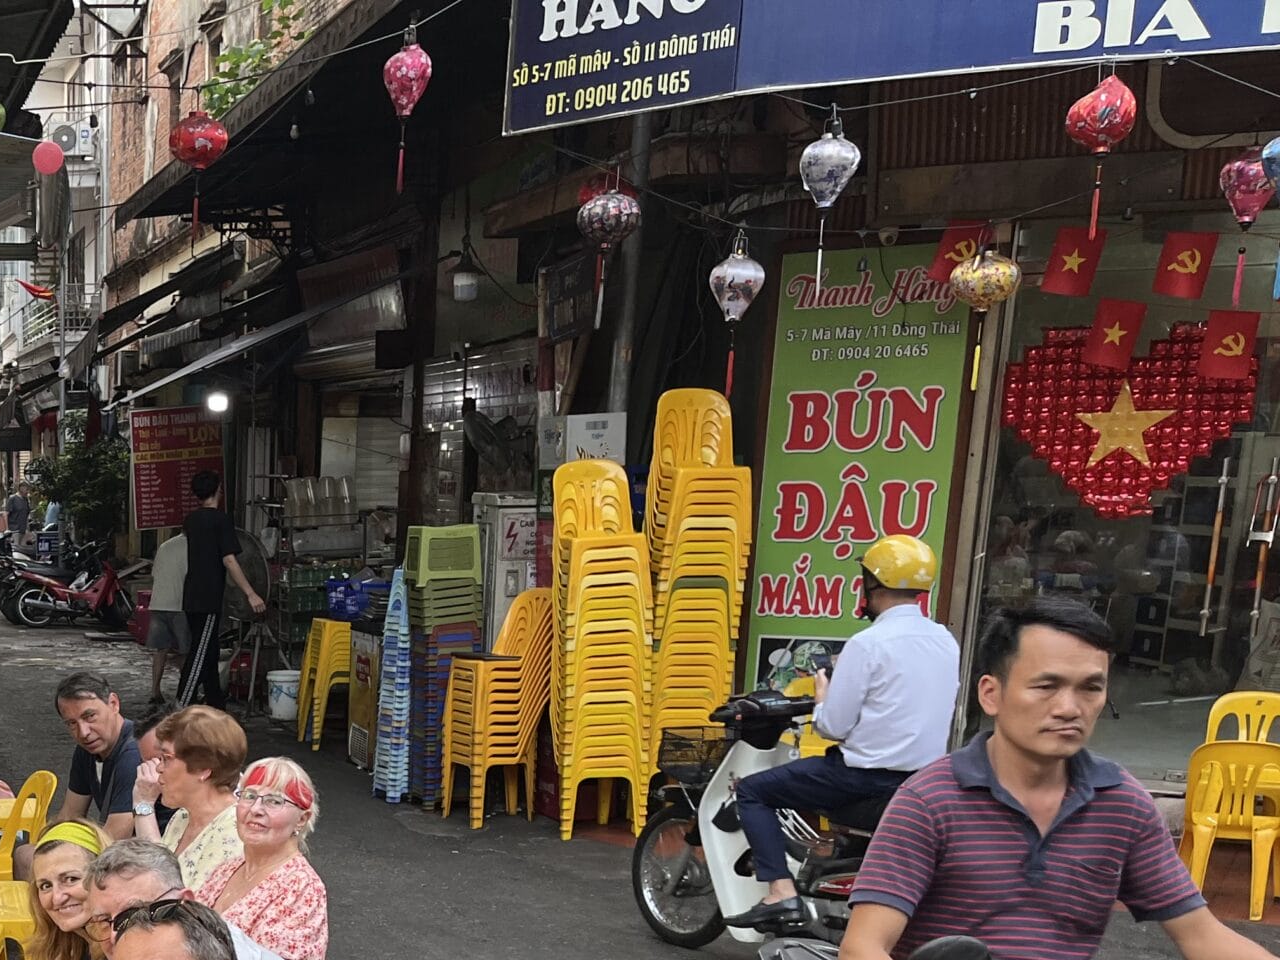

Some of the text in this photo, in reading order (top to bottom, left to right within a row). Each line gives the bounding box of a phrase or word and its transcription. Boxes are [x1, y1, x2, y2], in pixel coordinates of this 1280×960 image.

[531, 62, 552, 83] 5-7
[644, 42, 655, 62] 11
[702, 23, 736, 51] THÁI
[1032, 0, 1211, 53] BIA
[574, 83, 617, 111] 0904
[621, 76, 653, 103] 206
[658, 70, 690, 96] 465
[786, 268, 874, 310] Thanh
[787, 329, 808, 342] 5-7
[835, 326, 863, 342] Mây
[932, 320, 960, 334] Thái
[838, 347, 870, 360] 0904
[875, 346, 891, 358] 20
[895, 344, 929, 357] 6465
[782, 370, 945, 453] BÚN
[772, 462, 938, 560] ĐẬU
[756, 553, 845, 618] MẮM
